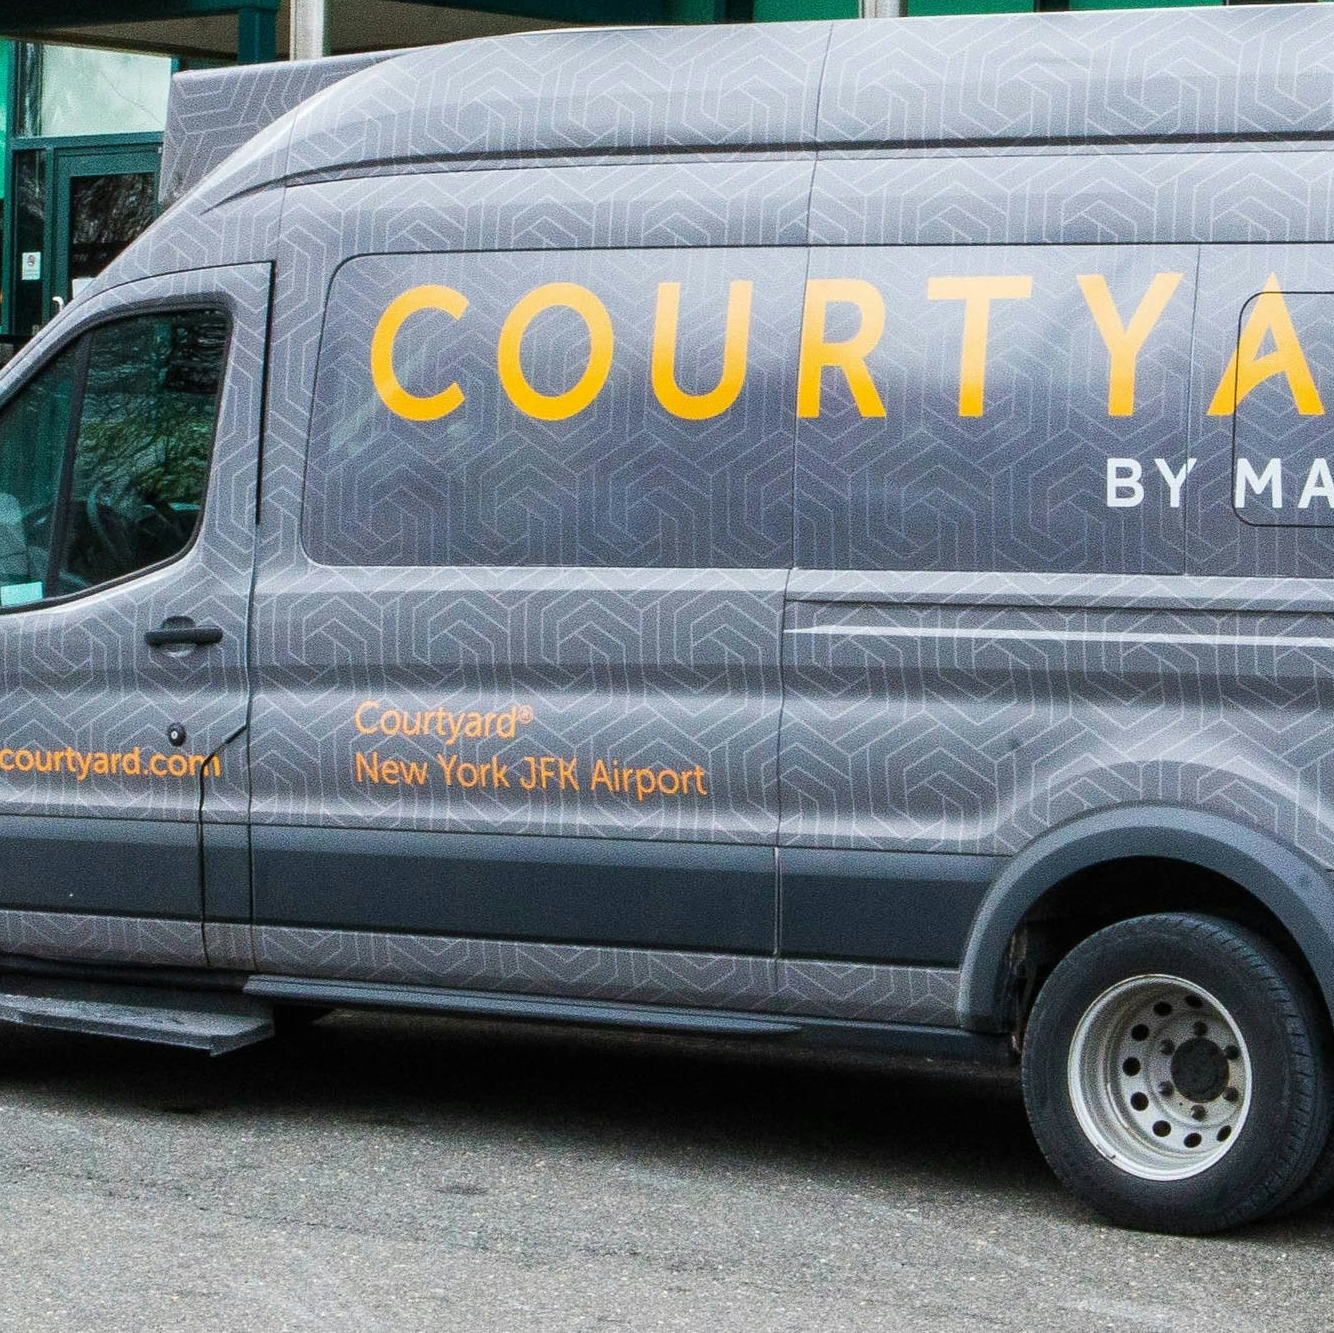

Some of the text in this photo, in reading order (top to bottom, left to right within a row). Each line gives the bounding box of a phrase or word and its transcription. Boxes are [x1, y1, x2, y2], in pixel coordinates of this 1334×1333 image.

[1106, 457, 1198, 510] BY
[354, 751, 708, 803] New York JFK Airport
